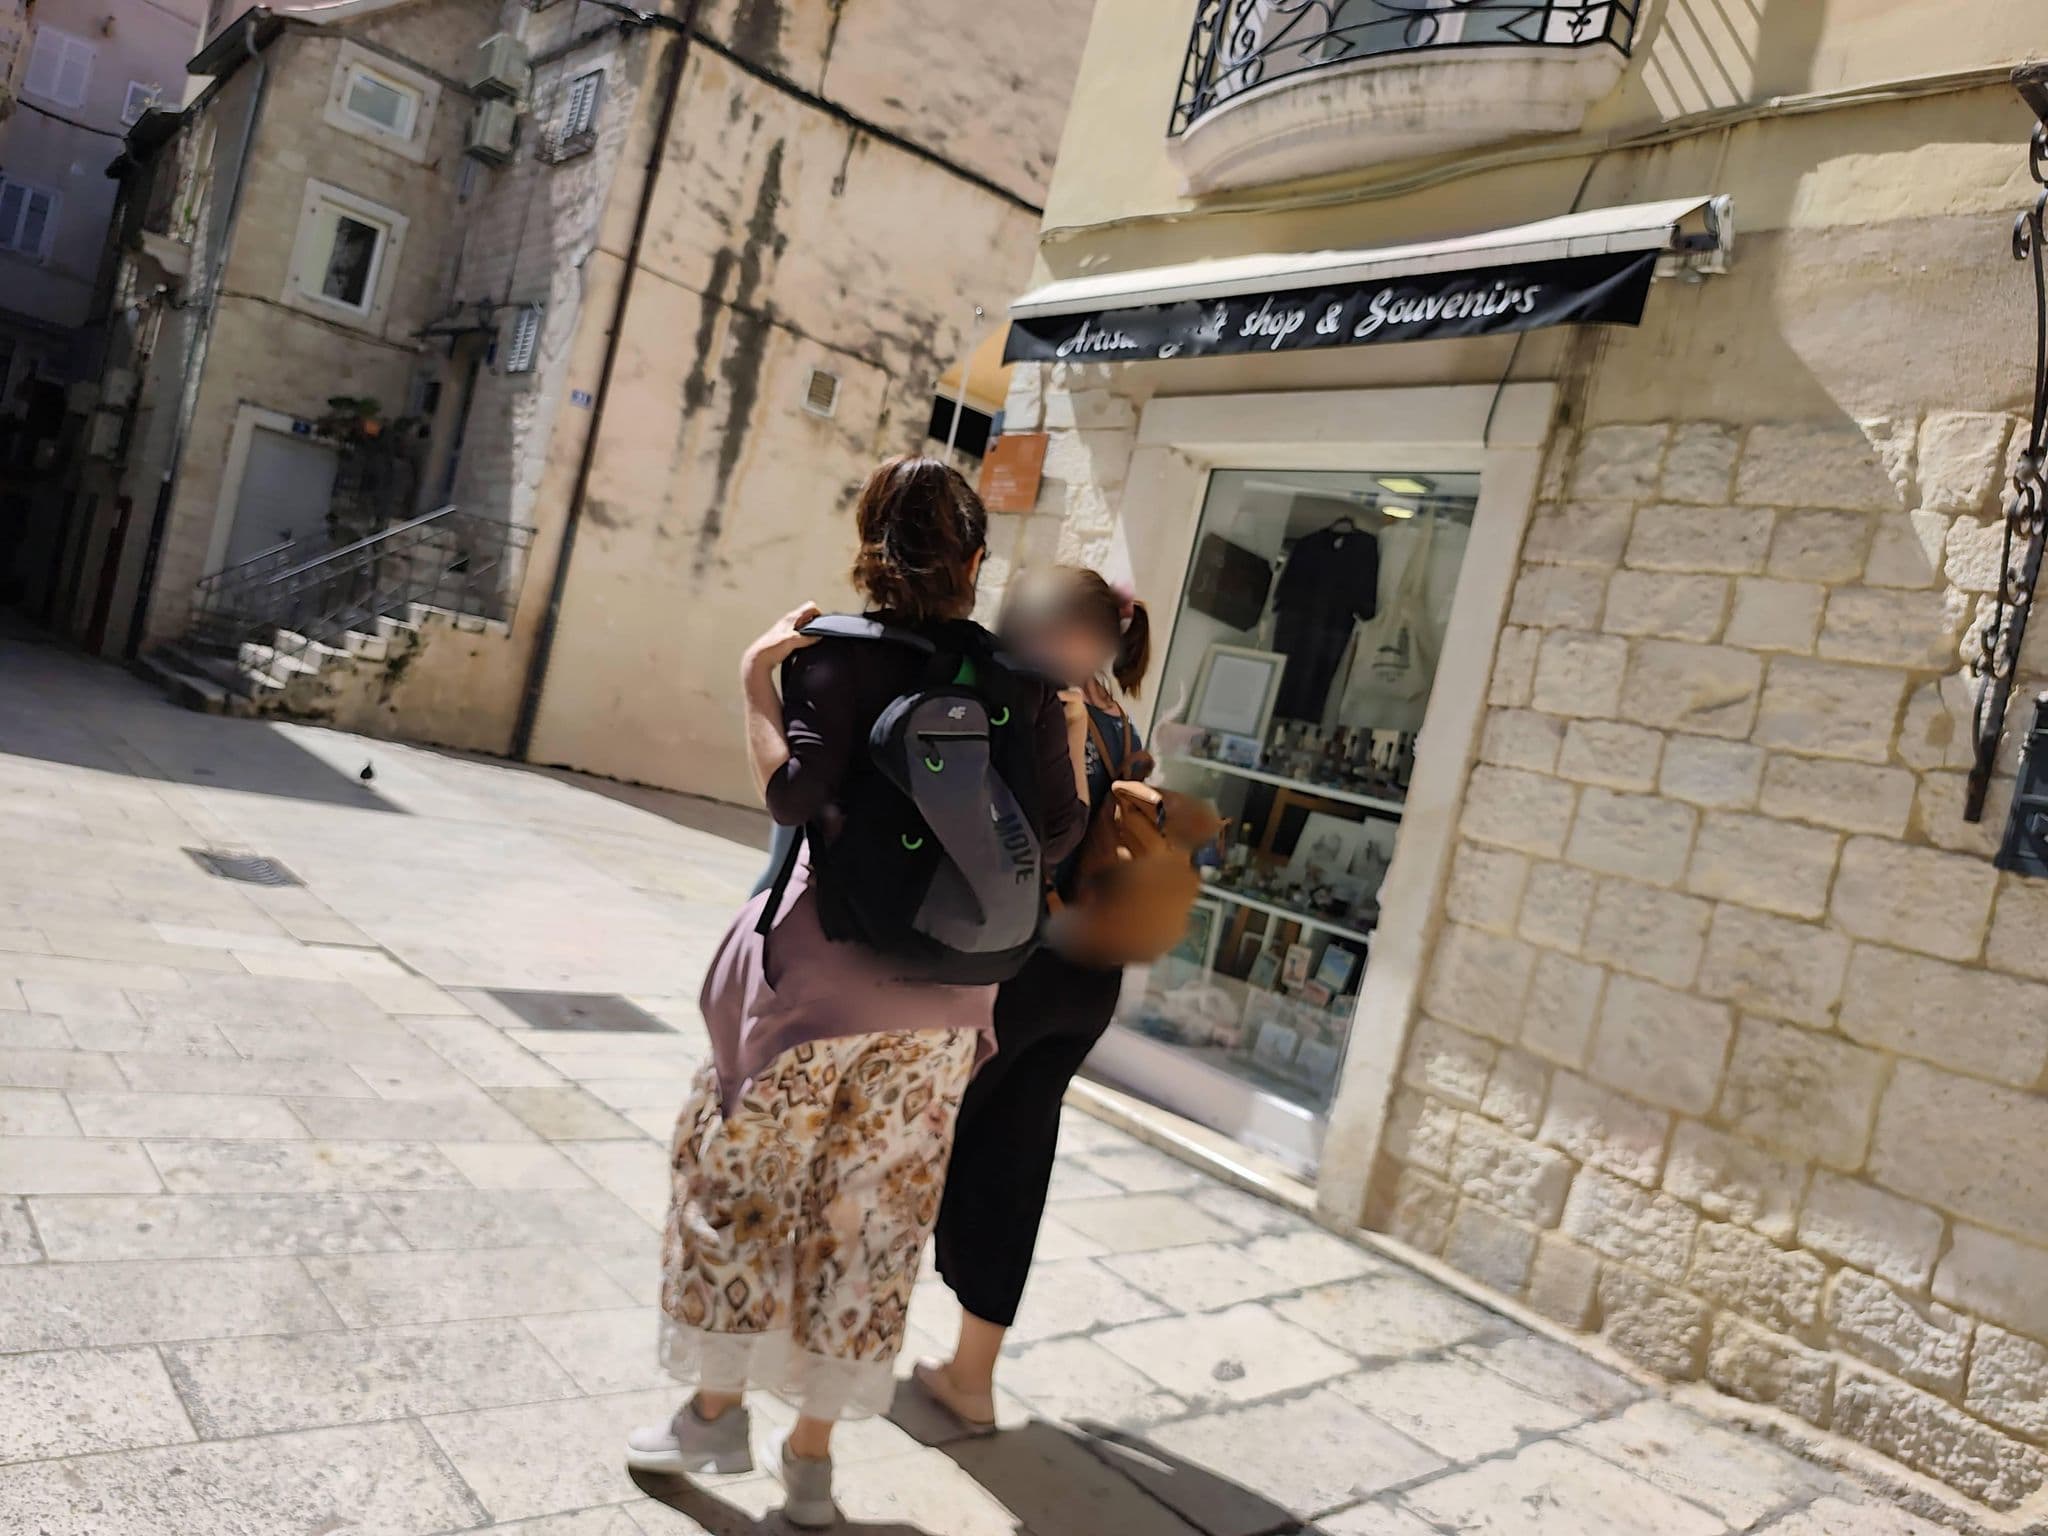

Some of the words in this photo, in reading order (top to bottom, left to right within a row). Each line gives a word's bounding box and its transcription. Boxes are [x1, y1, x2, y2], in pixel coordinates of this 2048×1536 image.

[1239, 296, 1306, 350] shop
[1316, 301, 1344, 335] &
[1353, 280, 1542, 338] Souvenirs
